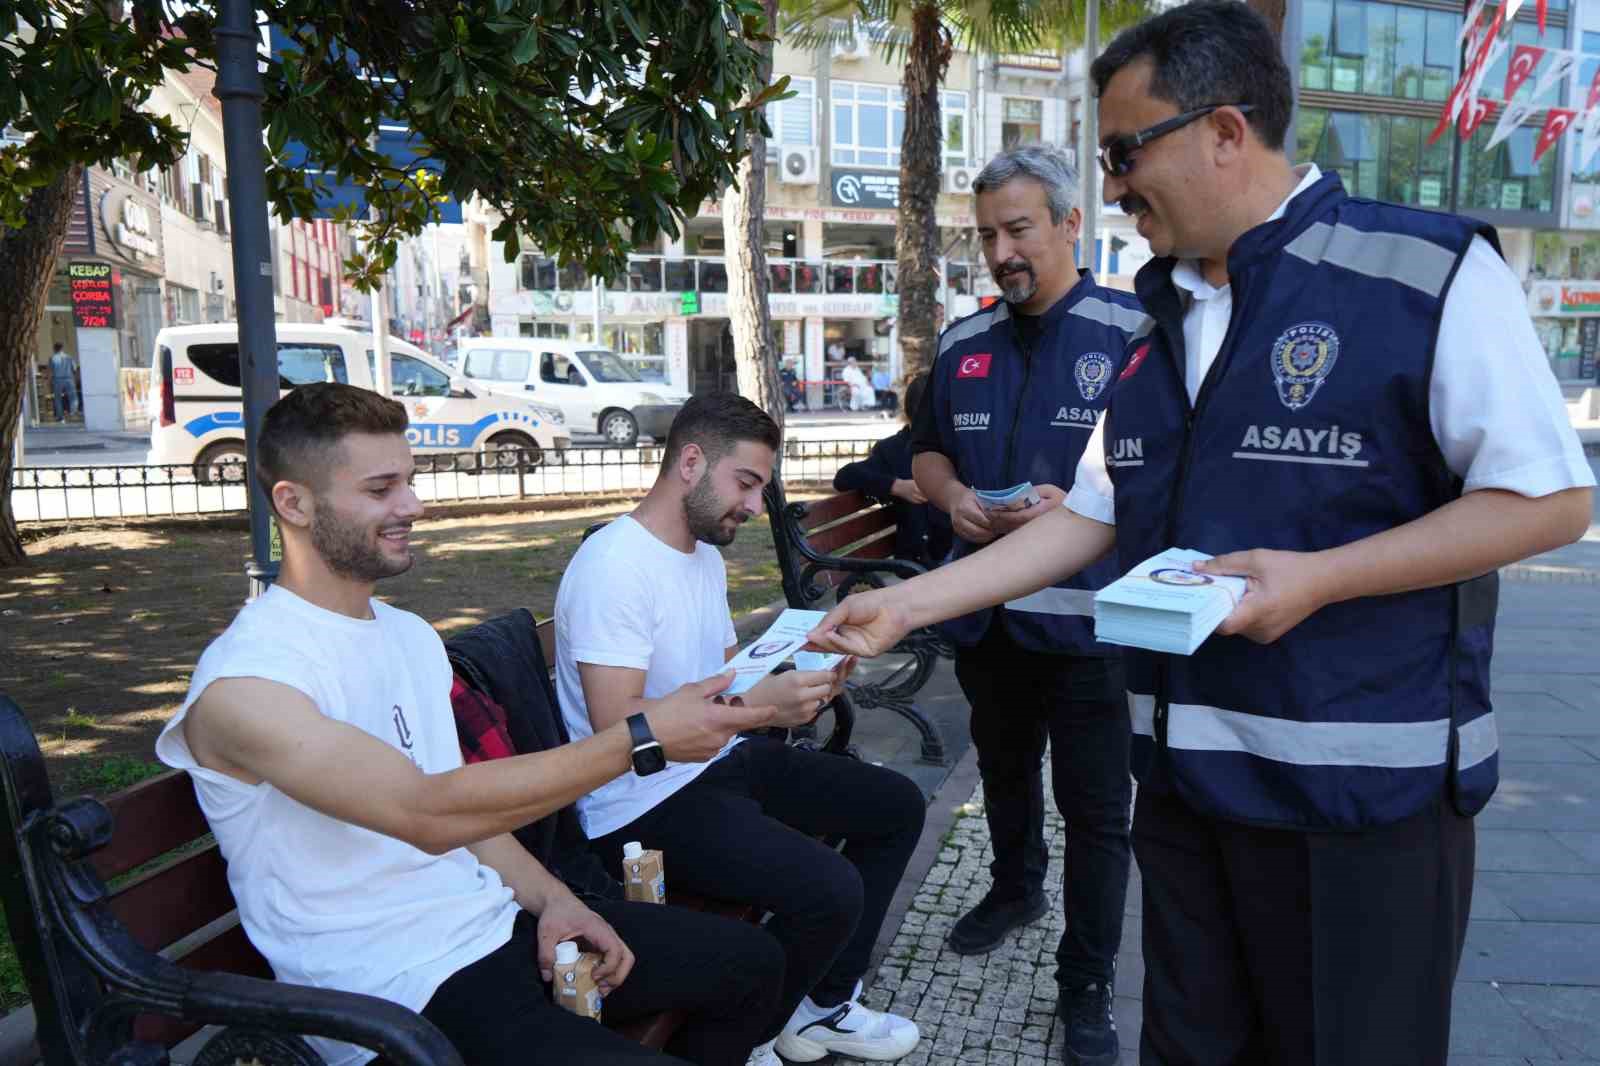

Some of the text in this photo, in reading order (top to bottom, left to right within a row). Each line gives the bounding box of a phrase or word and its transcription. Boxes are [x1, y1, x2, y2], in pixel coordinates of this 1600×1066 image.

[70, 264, 110, 277] KEBAP
[953, 412, 990, 426] MSUN
[1056, 407, 1104, 424] ASAY
[404, 425, 460, 446] OLİS
[1241, 425, 1362, 460] ASAYİŞ
